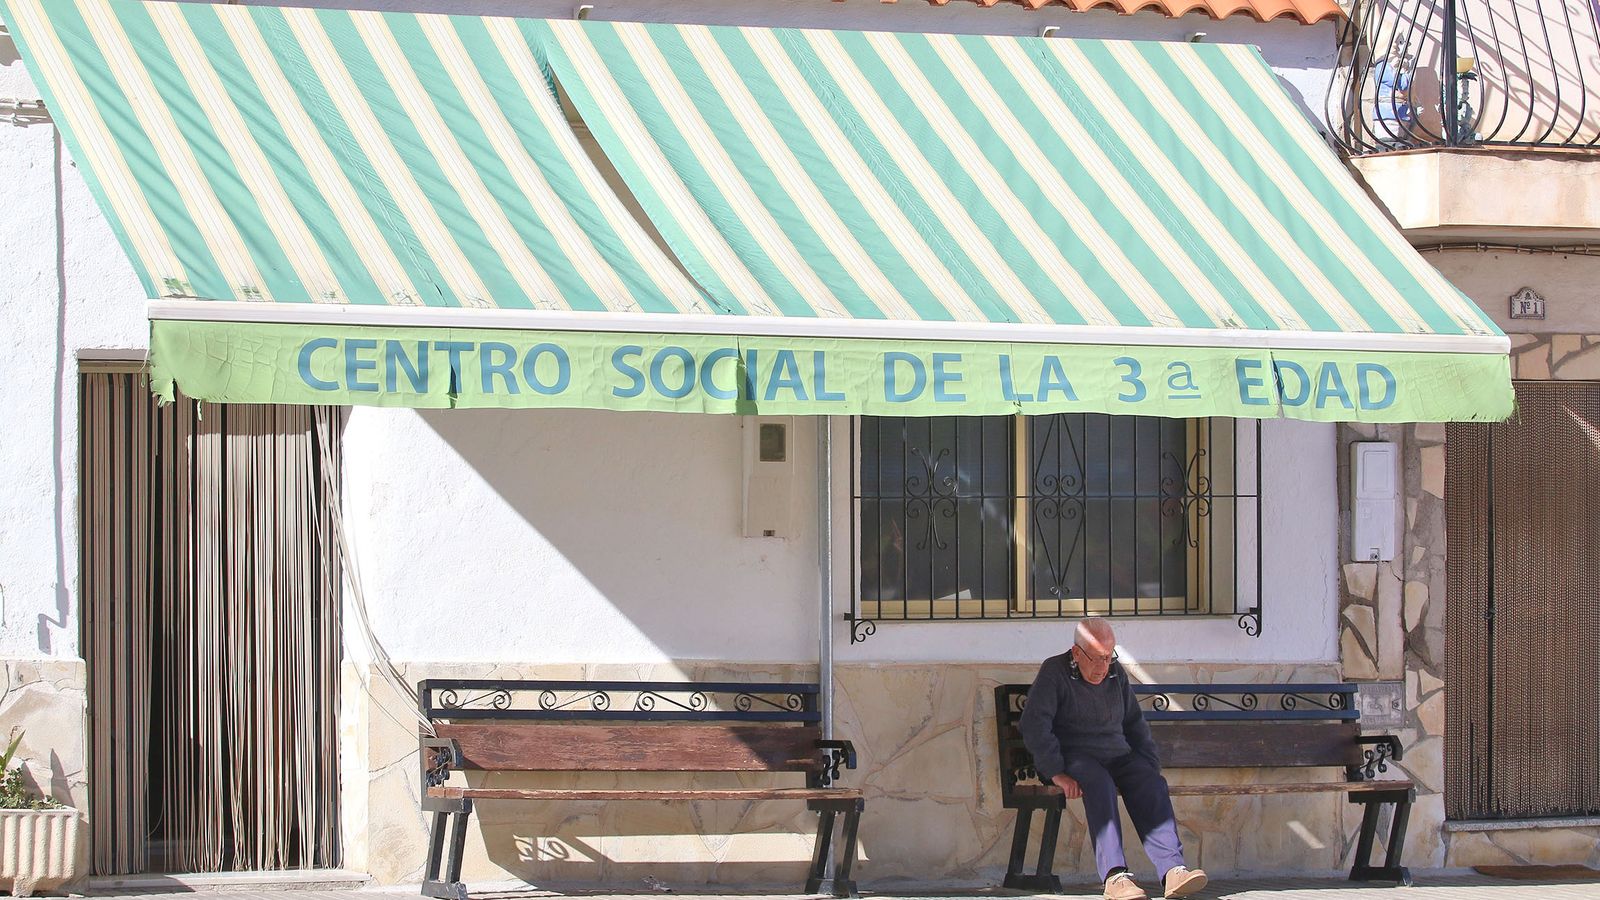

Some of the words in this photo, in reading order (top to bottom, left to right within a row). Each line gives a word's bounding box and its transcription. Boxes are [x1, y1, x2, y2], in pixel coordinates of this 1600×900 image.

[1533, 301, 1539, 314] 1
[298, 337, 571, 396] CENTRO
[611, 345, 846, 401] SOCIAL
[883, 352, 967, 404] DE
[998, 354, 1079, 402] LA
[1235, 358, 1397, 410] EDAD
